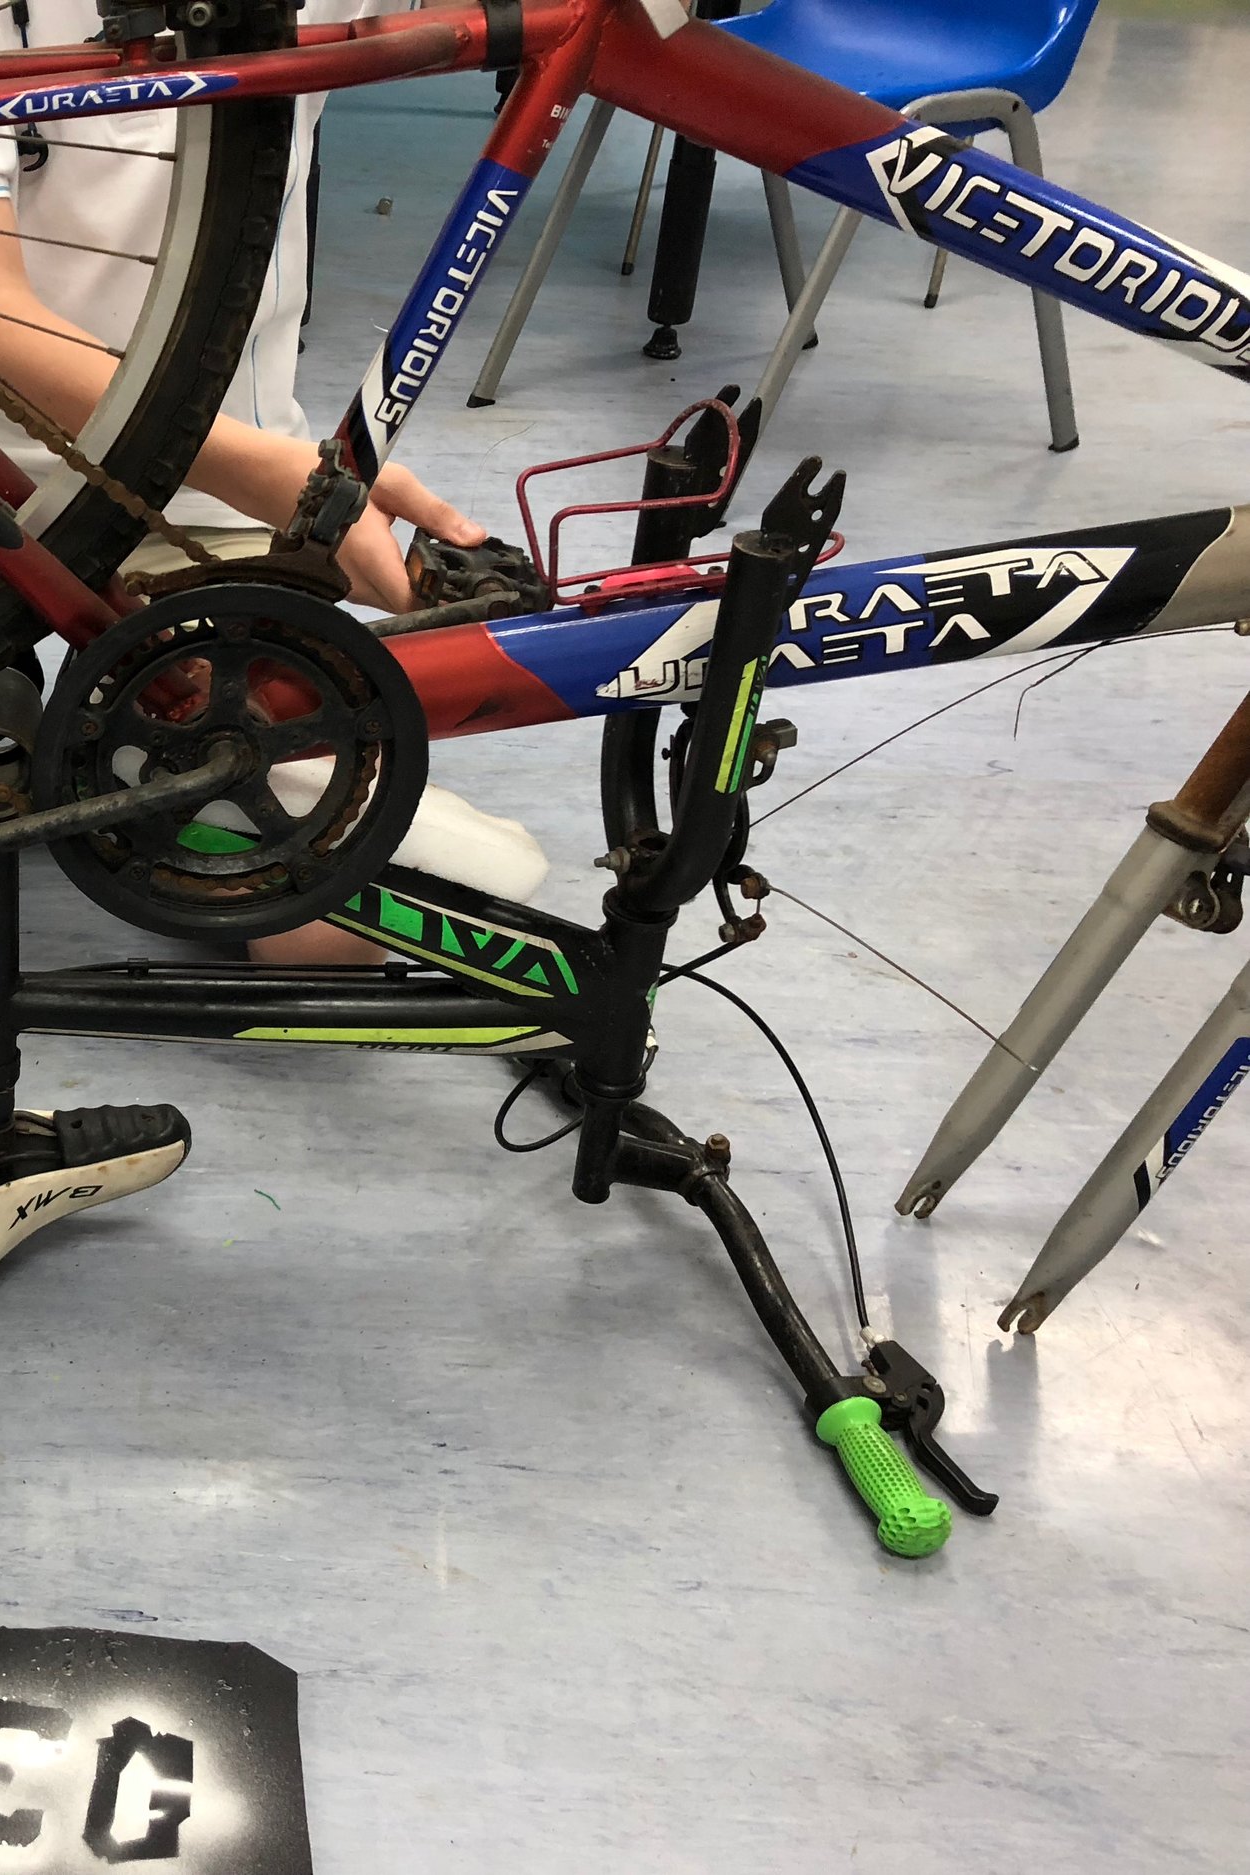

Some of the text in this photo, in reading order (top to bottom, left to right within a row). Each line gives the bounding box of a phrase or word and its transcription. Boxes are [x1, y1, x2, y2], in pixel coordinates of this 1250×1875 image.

[24, 80, 173, 115] URAETA
[887, 137, 1250, 363] VICETORIOU
[374, 189, 519, 426] VICETORIOUS
[782, 548, 1110, 633] RAETA
[7, 1184, 104, 1231] BMX
